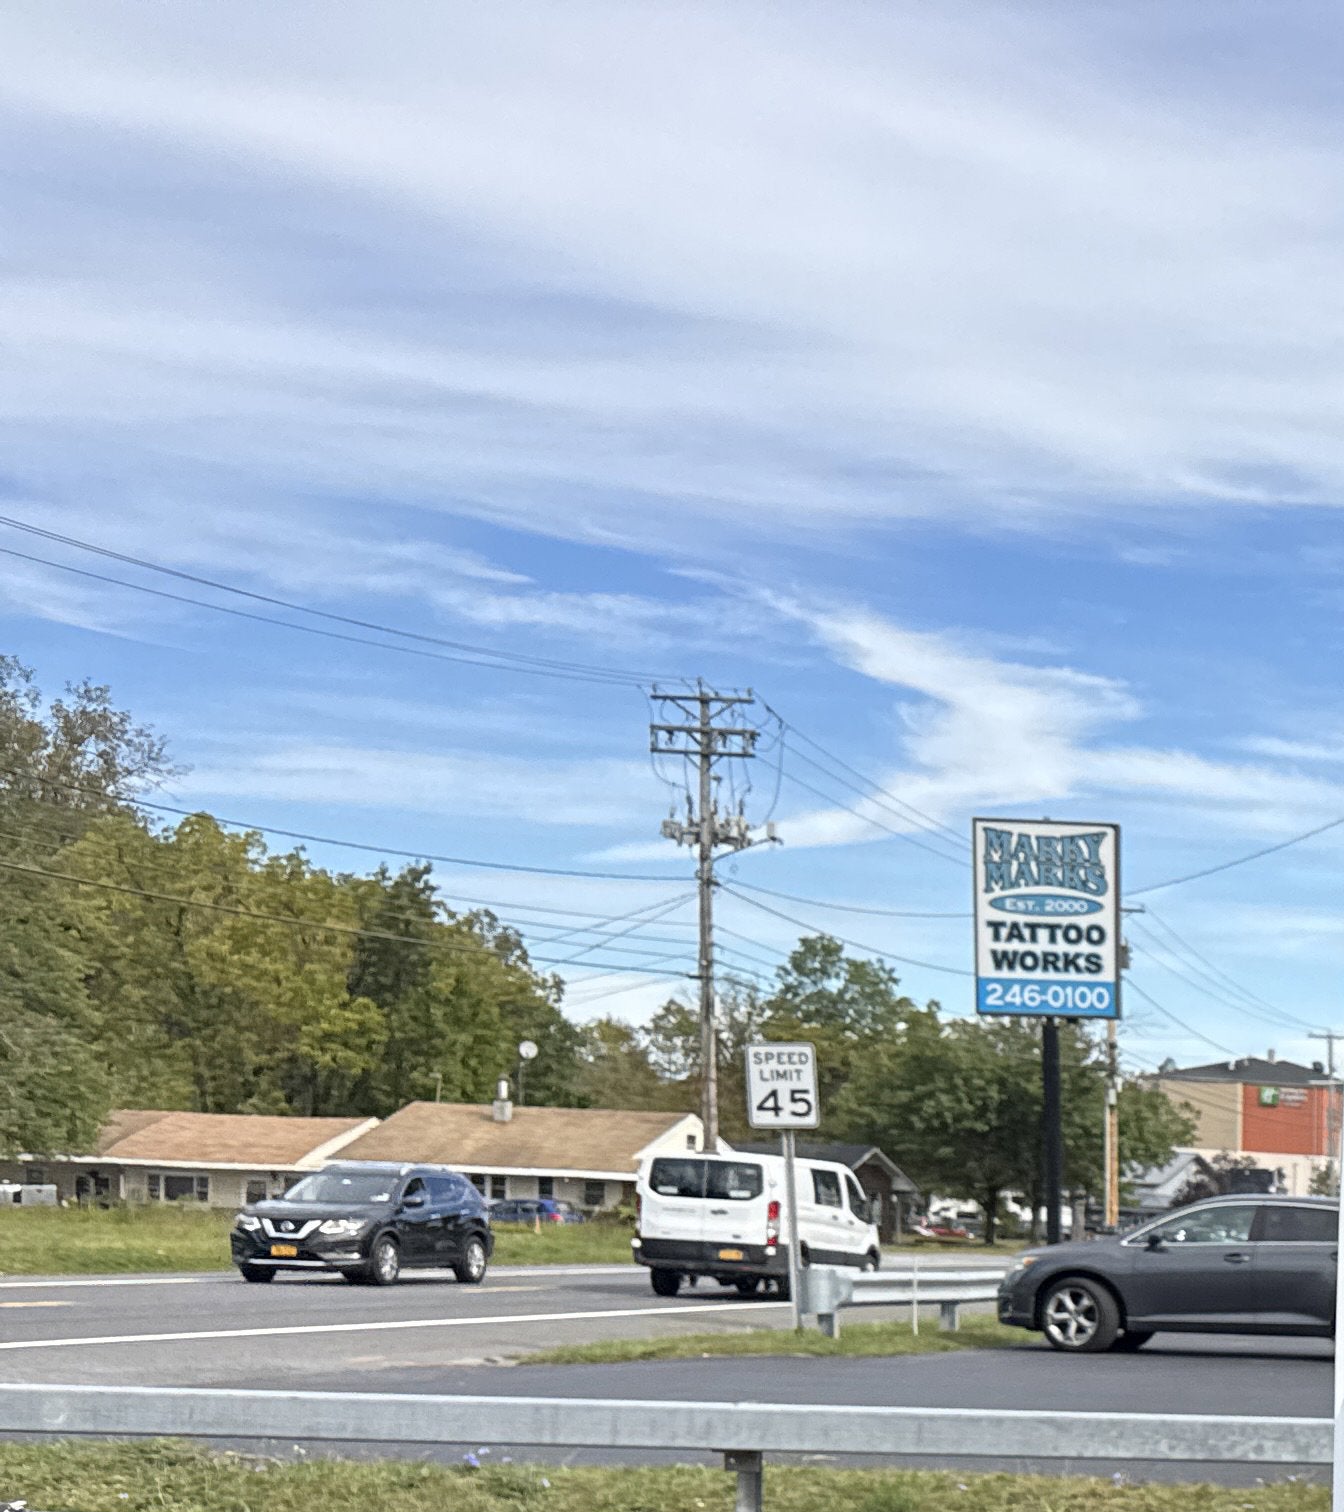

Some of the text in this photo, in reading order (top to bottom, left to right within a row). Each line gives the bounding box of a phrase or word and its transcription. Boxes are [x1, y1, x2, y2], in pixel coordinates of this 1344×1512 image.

[983, 827, 1108, 866] MARKY
[984, 860, 1108, 896] MARKS
[1044, 899, 1089, 913] 2000
[986, 921, 1106, 945] TATTOO
[990, 949, 1103, 974] WORKS
[985, 983, 1110, 1009] 246-0100
[753, 1051, 809, 1065] SPEED
[759, 1069, 803, 1082] LIMIT
[756, 1089, 812, 1118] 45
